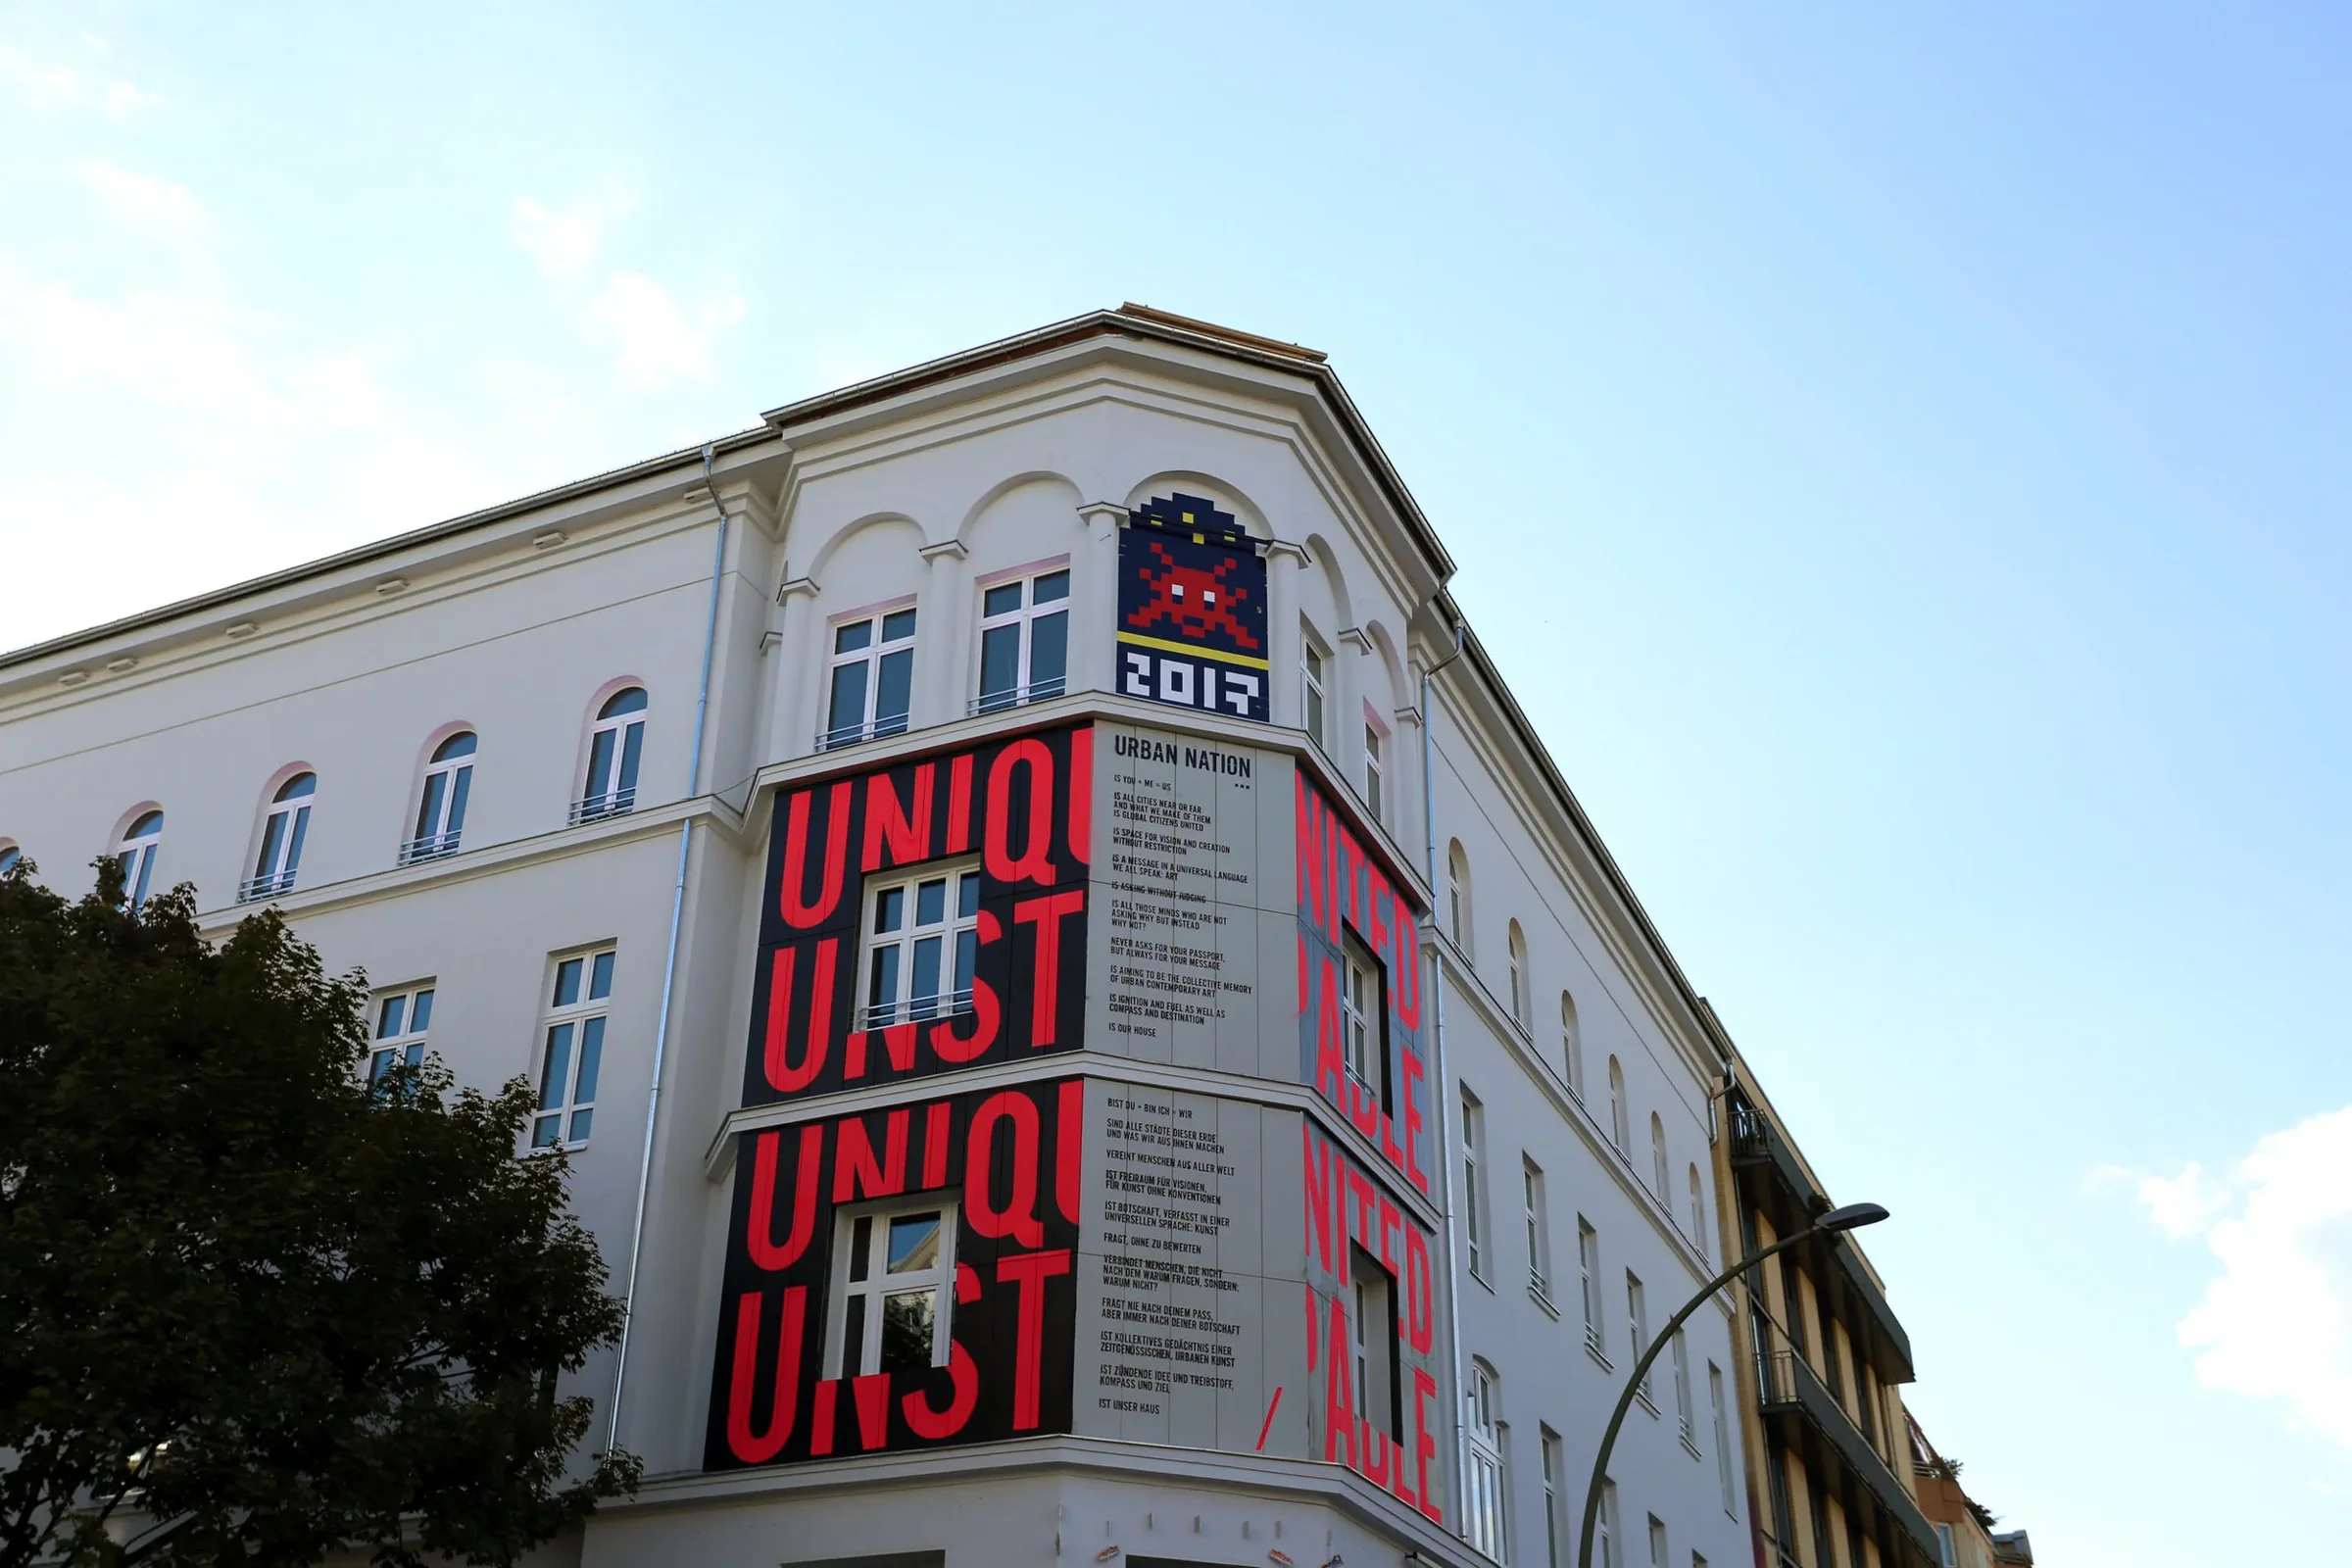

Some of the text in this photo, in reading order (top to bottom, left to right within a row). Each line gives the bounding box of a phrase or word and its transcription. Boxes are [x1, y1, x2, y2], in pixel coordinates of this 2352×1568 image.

[1127, 652, 1258, 715] 2017
[1115, 735, 1250, 778] URBAN NATION
[1123, 776, 1135, 785] YOU
[1114, 801, 1210, 824] AND WHAT MAKE THEM
[1123, 793, 1201, 813] ALL CITIES NEAR FAR
[1122, 810, 1203, 831] GLOBAL CITIZENS UNITED
[1113, 837, 1187, 856] WITHOUT RESTRICTION
[1122, 829, 1230, 854] SPACE FOR VISION AND CREATION
[1125, 865, 1137, 874] ALL
[1165, 871, 1178, 881] ART
[1128, 857, 1248, 884] MESSAGE UNIVERSAL LANGUAGE
[1121, 882, 1205, 904] ASKING WITHOUT JUDGING
[1111, 909, 1200, 930] ASKING WHY BUT INSTEAD
[1121, 901, 1227, 925] ALL THOSE MINDS WHO ARE NOT
[1111, 918, 1146, 931] WHY NOT?
[1111, 937, 1133, 948] NEVER
[1135, 940, 1152, 951] ASKS
[1155, 943, 1168, 954] FOR
[1170, 946, 1187, 956] YOUR
[1111, 946, 1220, 970] BUT ALWAYS FOR YOUR MESSAGE
[1119, 966, 1251, 995] AIMING THE COLLECTIVE MEMORY
[1121, 976, 1215, 998] URBAN CONTEMPORARY ART
[1109, 1004, 1204, 1025] COMPASS AND DESTINATION
[1118, 995, 1213, 1017] IGNITION AND FUEL WELL
[1118, 1023, 1156, 1037] OUR HOUSE
[1108, 1099, 1192, 1119] BIST BIN ICH WIR
[1107, 1118, 1123, 1129] SIND
[1126, 1121, 1143, 1132] ALLE
[1173, 1128, 1197, 1140] DIESER
[1200, 1132, 1215, 1143] ERDE
[1107, 1129, 1224, 1154] UND WAS WIR AUS IHNEN MACHEN
[1106, 1150, 1235, 1176] VEREINT MENSCHEN AUS ALLER WELT
[1106, 1169, 1117, 1180] IST
[1119, 1171, 1154, 1185] FREIRAUM
[1121, 1182, 1145, 1195] KUNST
[1147, 1186, 1165, 1198] OHNE
[1168, 1189, 1221, 1204] KONVENTIONEN
[1105, 1200, 1116, 1211] IST
[1163, 1208, 1198, 1222] VERFASST
[1210, 1215, 1230, 1227] EINER
[1105, 1211, 1156, 1227] UNIVERSELLEN
[1195, 1224, 1218, 1236] KUNST
[1131, 1236, 1150, 1248] OHNE
[1163, 1241, 1201, 1254] BEWERTEN
[1103, 1265, 1123, 1276] NACH
[1125, 1268, 1141, 1279] DEM
[1144, 1270, 1169, 1282] WARUM
[1104, 1254, 1143, 1268] VERBINDET
[1188, 1265, 1199, 1276] DIE
[1201, 1267, 1222, 1279] NICHT
[1103, 1276, 1157, 1292] WARUM NICHT?
[1102, 1298, 1125, 1309] FRAGT
[1128, 1300, 1140, 1311] NIE
[1142, 1302, 1161, 1313] NACH
[1164, 1305, 1190, 1317] DEINEM
[1102, 1308, 1240, 1335] ABER IMMER NACH DEINER BOTSCHAFT
[1101, 1331, 1112, 1342] IST
[1115, 1333, 1162, 1348] KOLLEKTIVES
[1211, 1345, 1231, 1356] EINER
[1175, 1351, 1235, 1368] URBANEN KUNST
[1101, 1364, 1111, 1375] IST
[1154, 1371, 1170, 1382] IDEE
[1173, 1373, 1188, 1384] UND
[1100, 1376, 1170, 1394] KOMPASS UND ZIEL
[1100, 1398, 1159, 1414] IST UNSER HAUS
